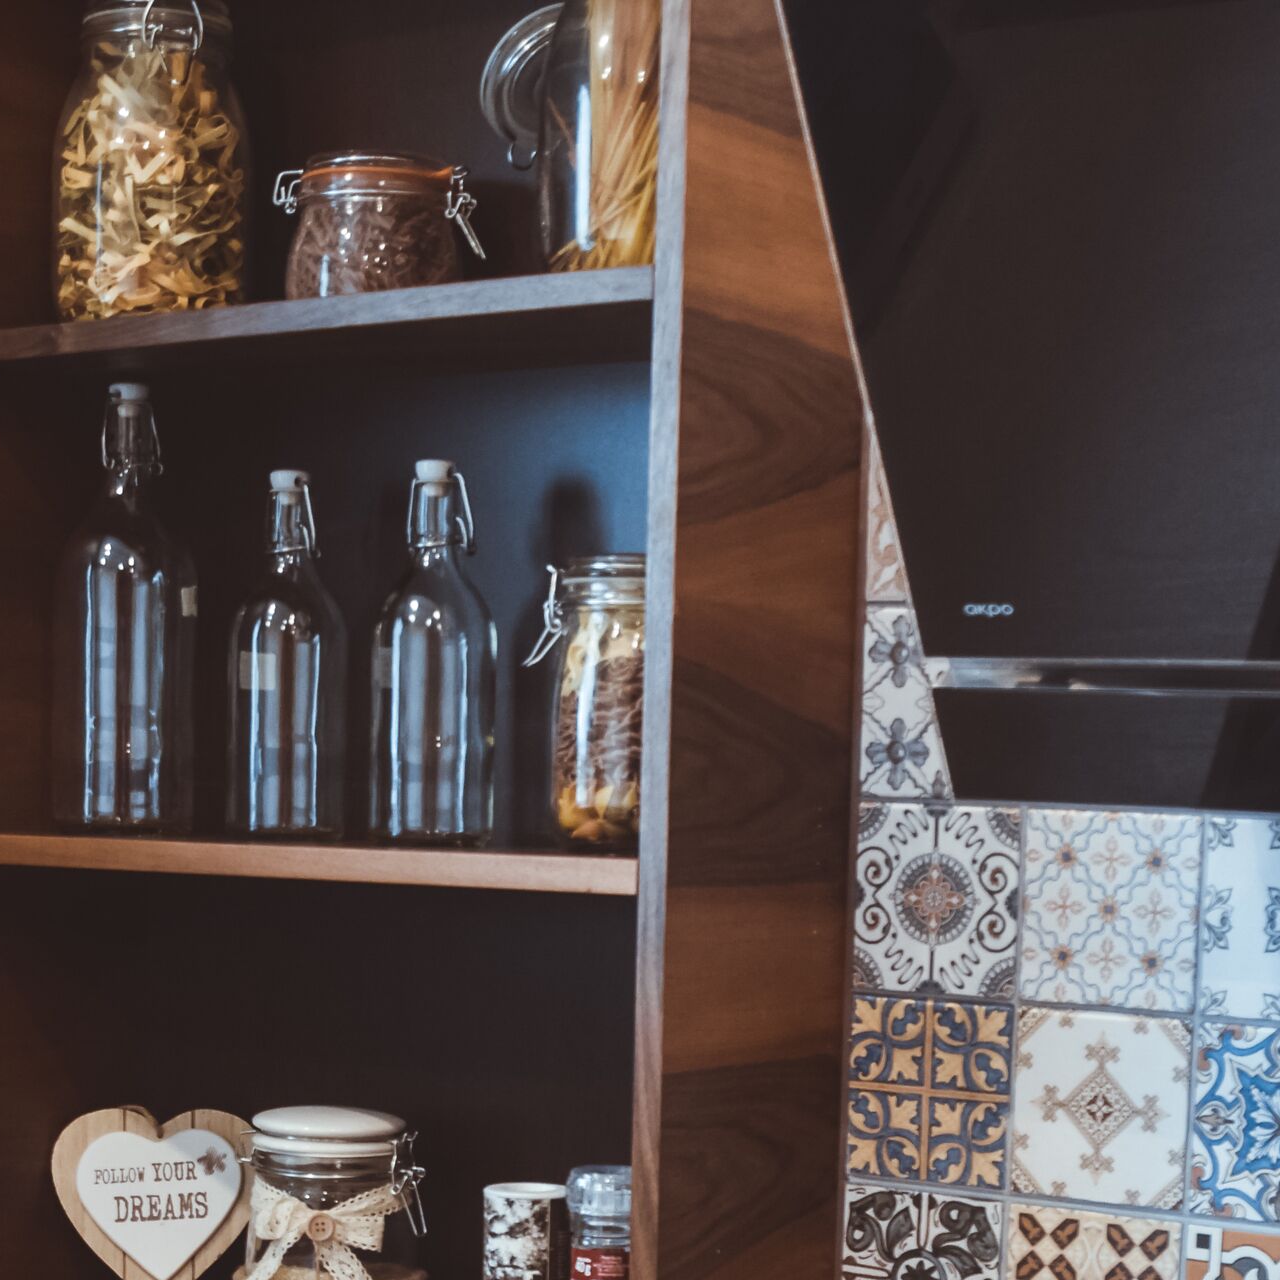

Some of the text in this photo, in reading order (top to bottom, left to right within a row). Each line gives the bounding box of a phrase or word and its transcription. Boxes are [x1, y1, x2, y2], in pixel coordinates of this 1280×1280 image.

[963, 603, 1014, 617] akpo
[94, 1161, 197, 1185] FOLLOW YOUR
[114, 1192, 208, 1223] DREAMS
